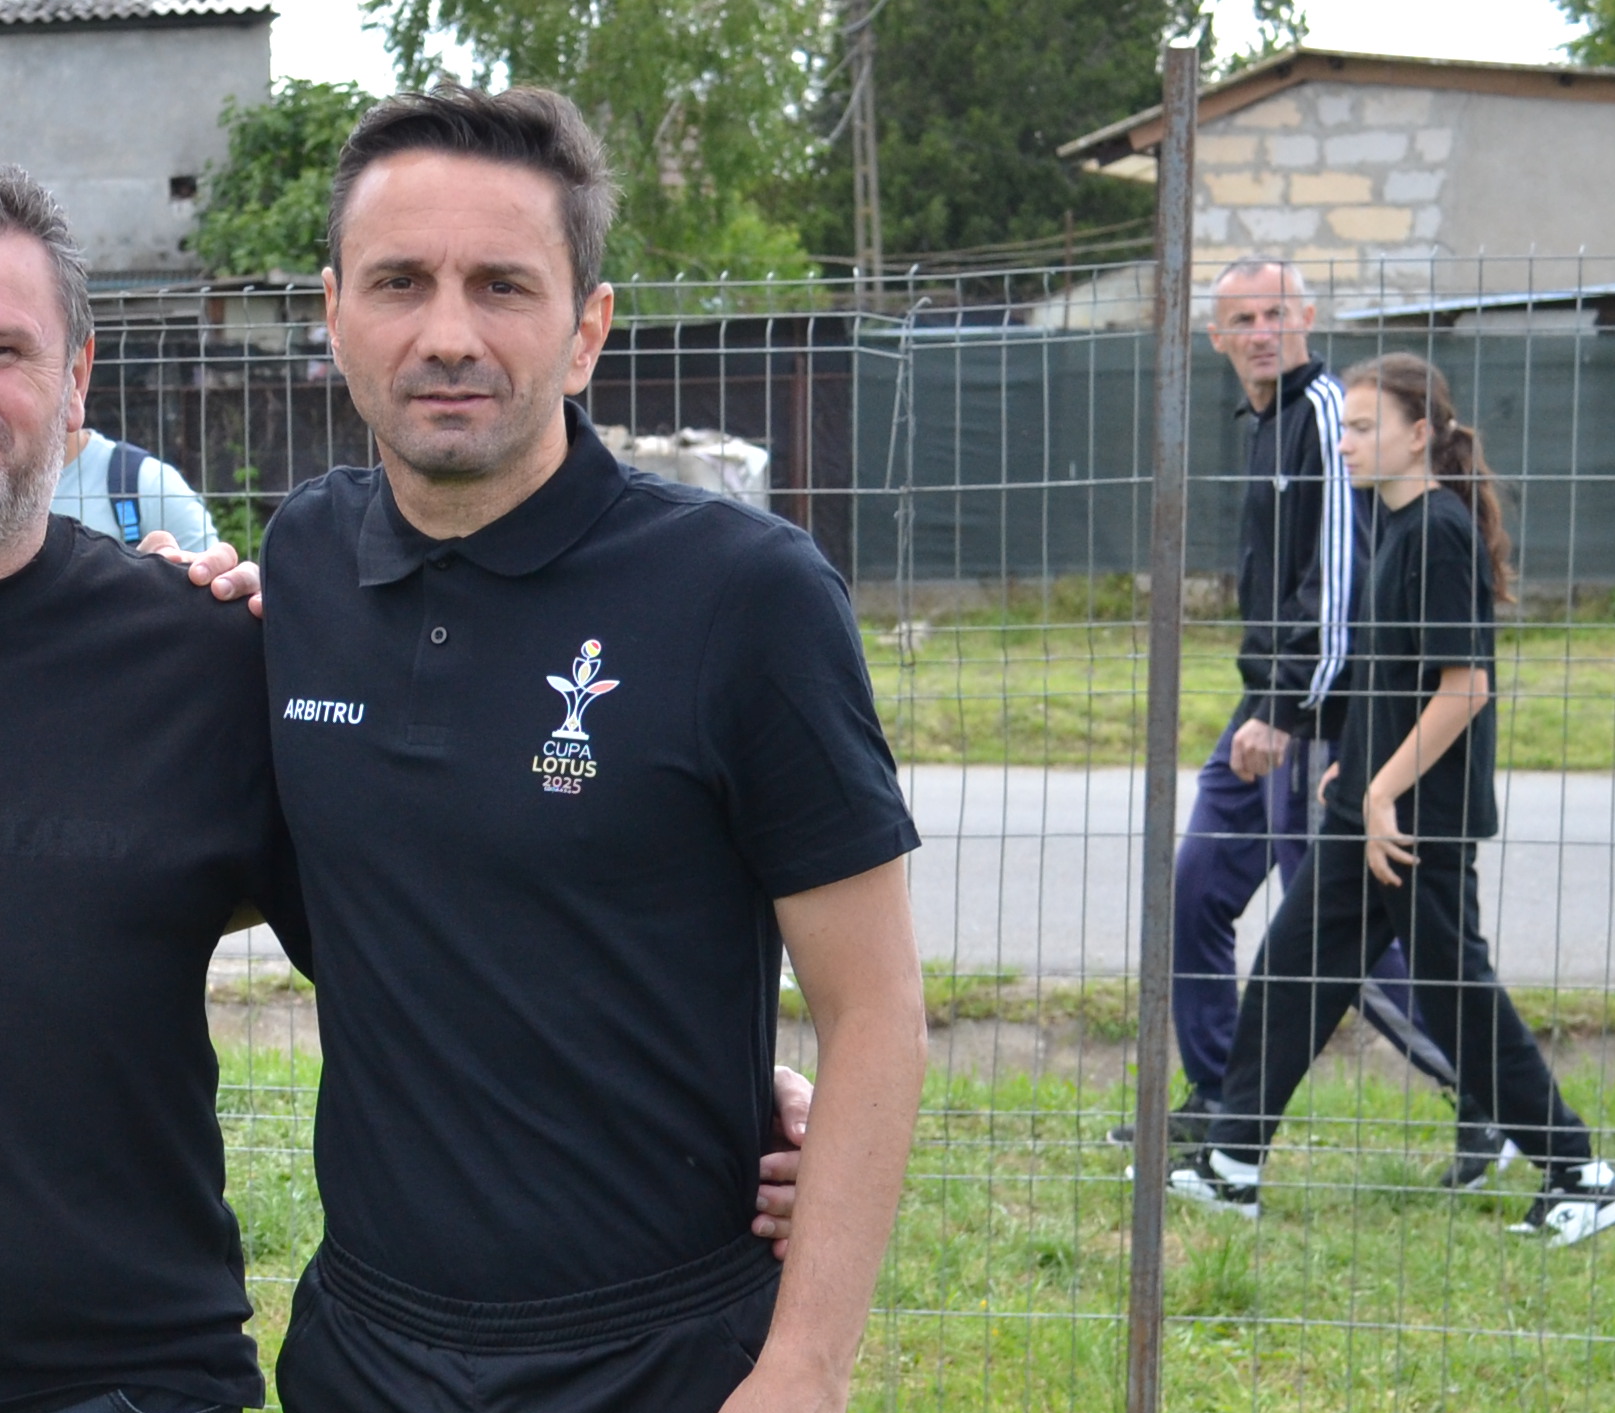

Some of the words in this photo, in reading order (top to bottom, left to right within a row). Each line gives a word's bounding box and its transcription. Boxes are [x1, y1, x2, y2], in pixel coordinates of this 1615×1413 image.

[282, 698, 364, 724] ARBITRU
[542, 740, 592, 760] CUPA
[531, 755, 598, 778] LOTUS
[542, 774, 583, 795] 2025
